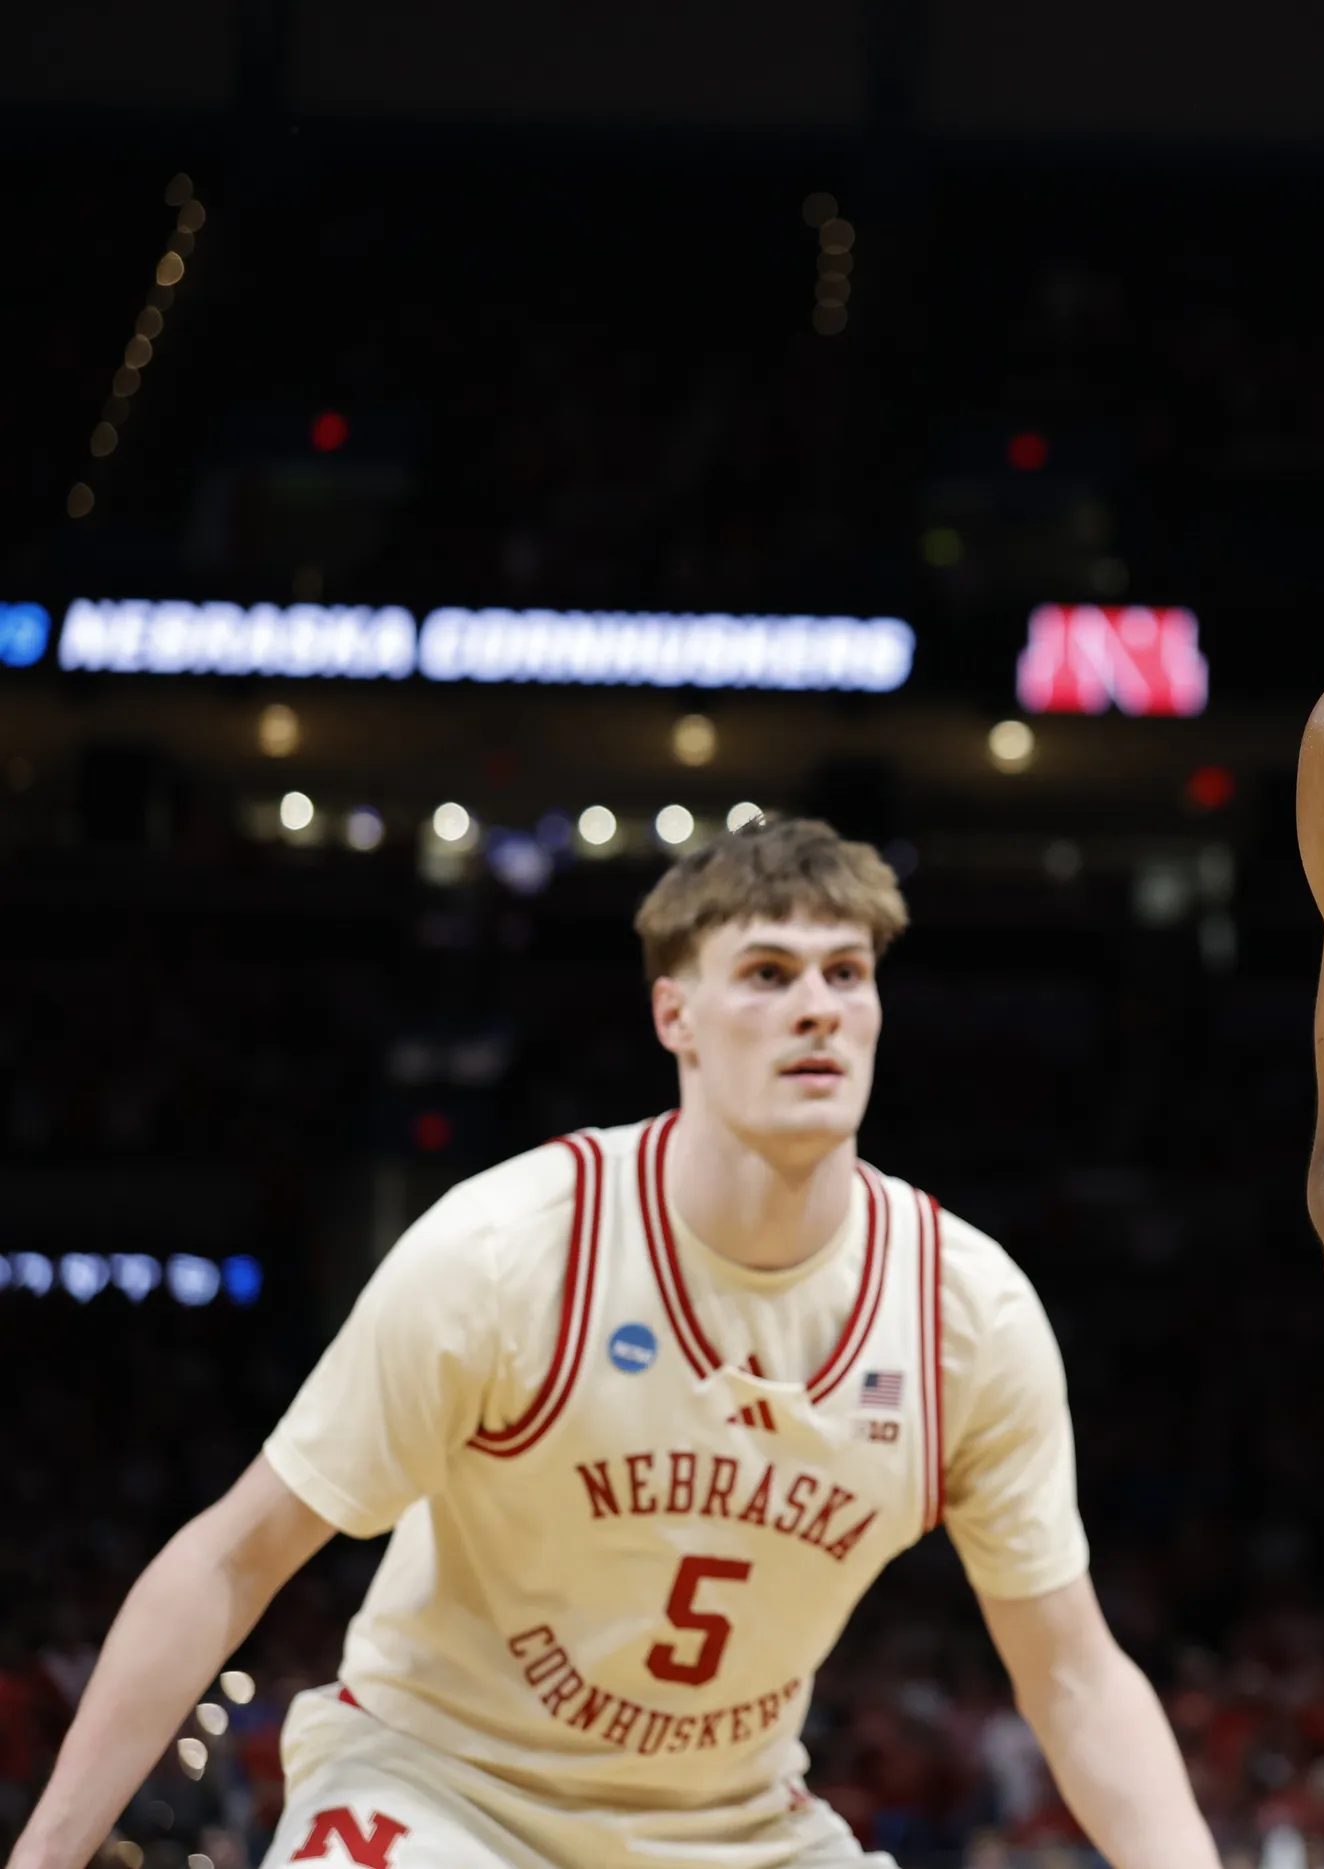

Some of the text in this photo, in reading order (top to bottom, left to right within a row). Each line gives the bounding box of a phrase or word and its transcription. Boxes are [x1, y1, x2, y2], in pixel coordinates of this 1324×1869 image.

[575, 1451, 881, 1562] NEBRASKA
[645, 1554, 754, 1687] 5
[290, 1806, 411, 1869] N
